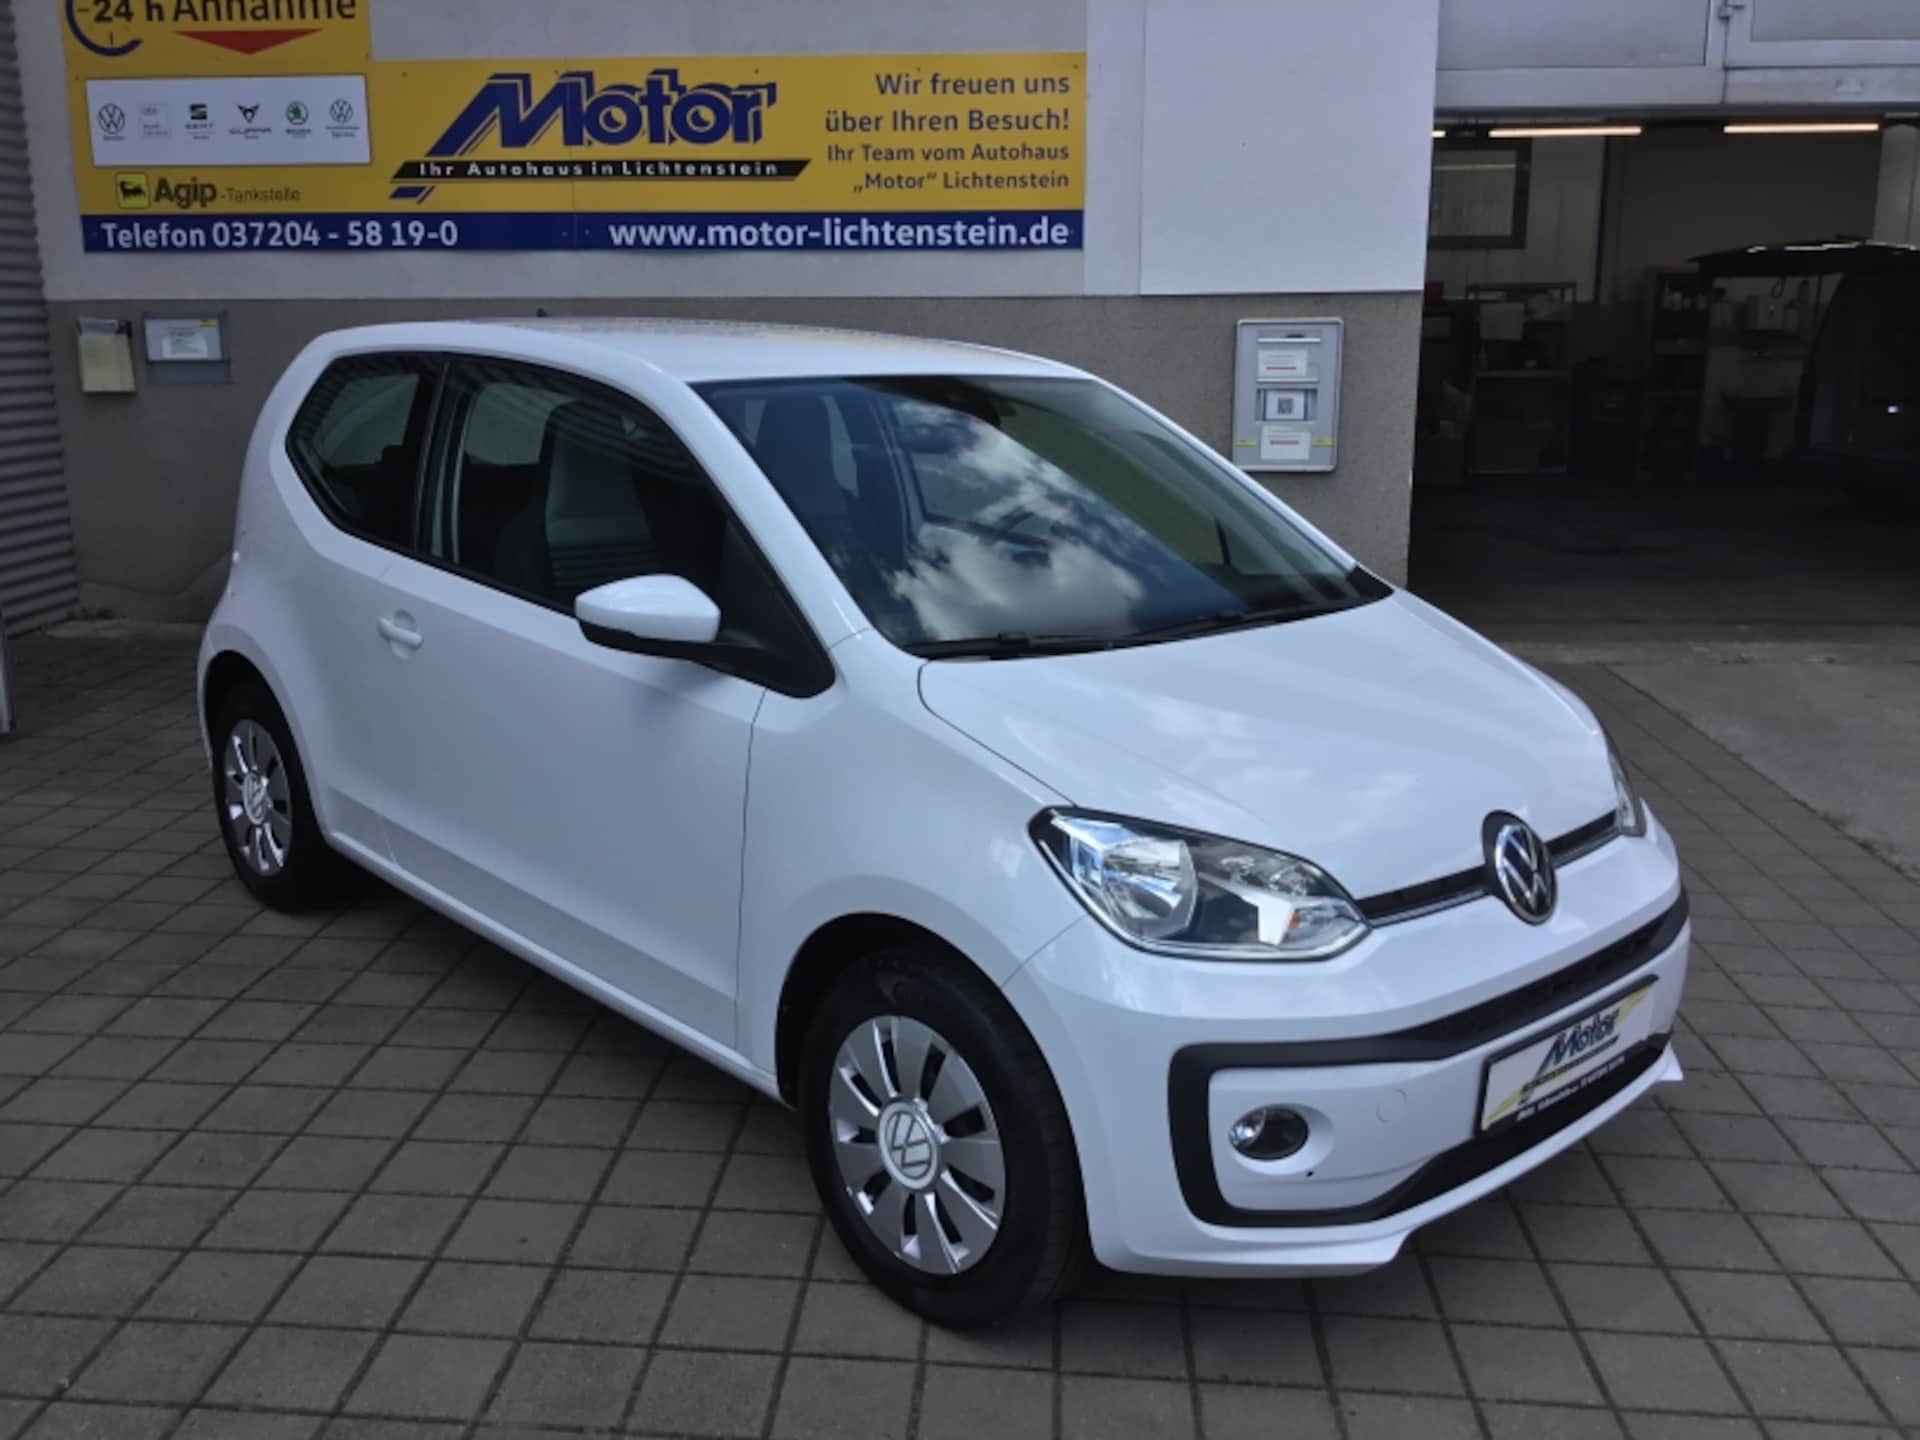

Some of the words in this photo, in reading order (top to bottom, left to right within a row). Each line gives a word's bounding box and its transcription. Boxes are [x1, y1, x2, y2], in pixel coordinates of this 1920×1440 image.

[93, 0, 133, 22] 24
[146, 0, 165, 21] h
[875, 73, 922, 95] Wir
[931, 73, 1015, 94] freuen
[1025, 76, 1070, 93] uns
[423, 68, 777, 157] Motor
[825, 110, 883, 132] über
[892, 110, 958, 132] Ihren
[968, 108, 1069, 131] Besuch!
[828, 145, 853, 161] Ihr
[862, 145, 914, 161] Team
[922, 148, 963, 161] vom
[971, 144, 1069, 160] Autohaus
[420, 163, 455, 176] Ihr
[467, 162, 583, 176] Autohaus
[591, 161, 614, 176] in
[622, 161, 778, 176] Lichtenstein
[944, 170, 1069, 189] Lichtenstein
[155, 177, 217, 208] Agip
[100, 222, 206, 248] Telefon
[212, 221, 320, 247] 037204
[347, 221, 382, 246] 58
[391, 220, 458, 246] 19-0
[609, 217, 1069, 248] www.motor-lichtenstein.de
